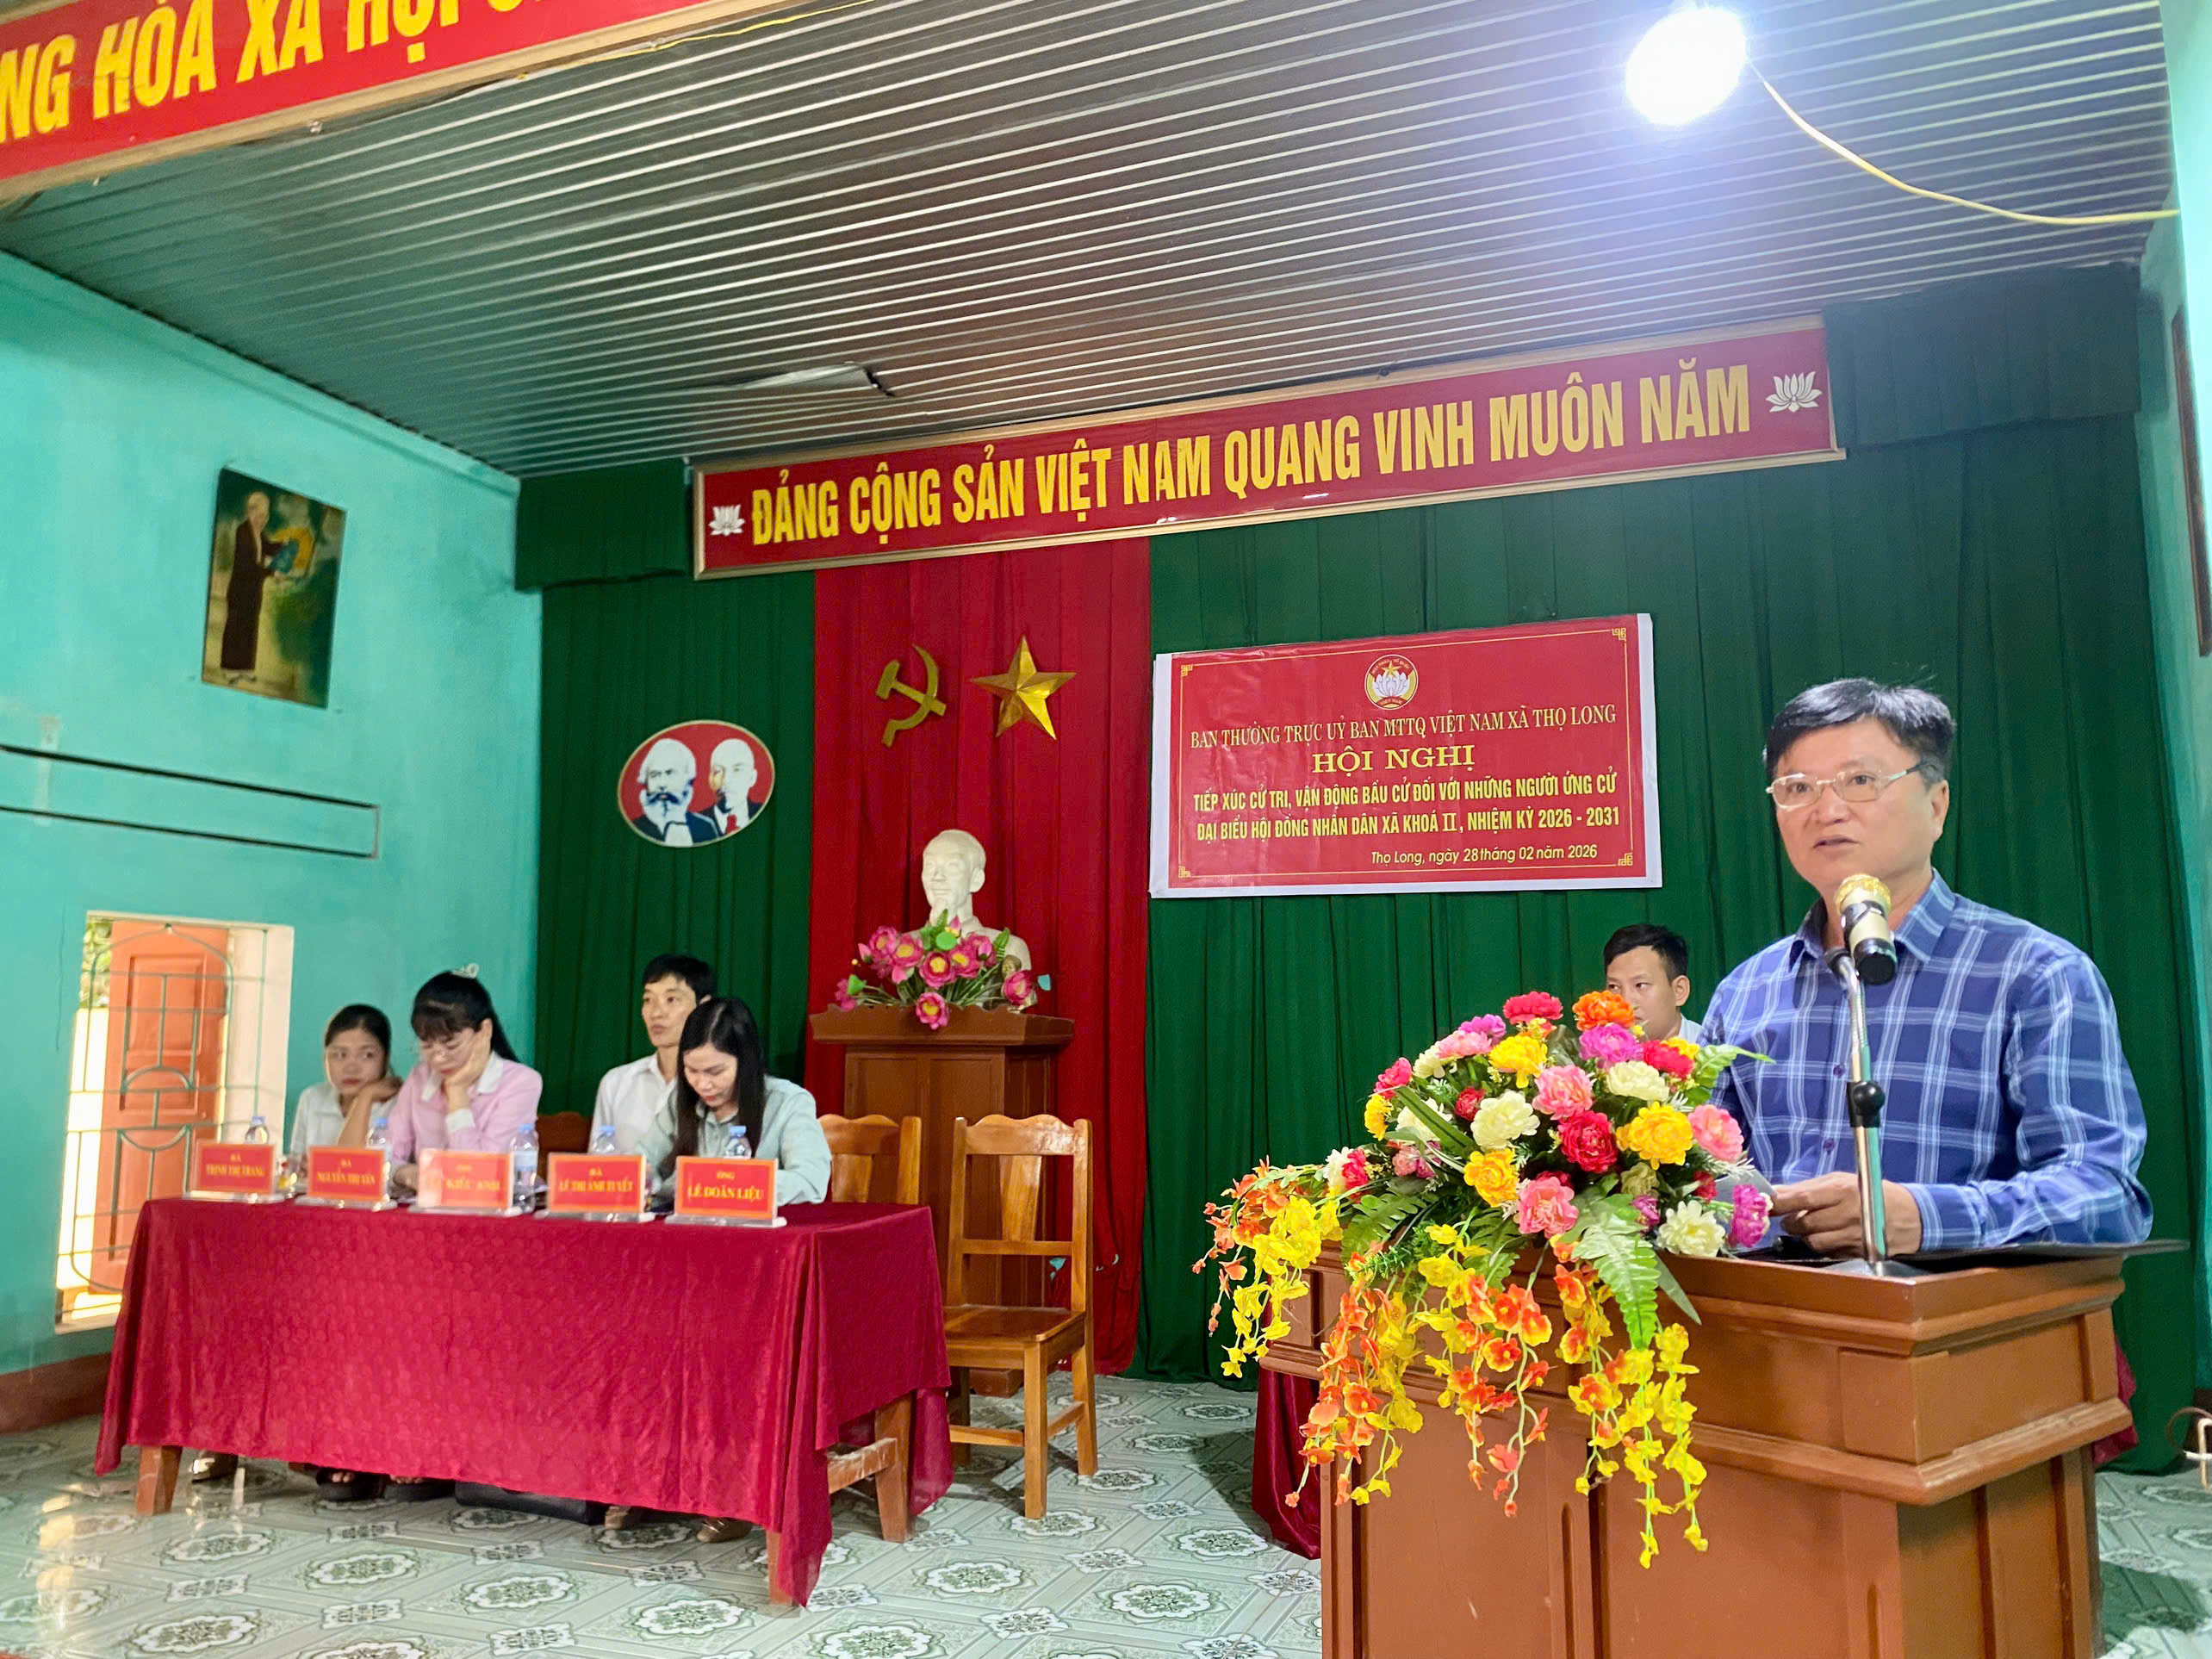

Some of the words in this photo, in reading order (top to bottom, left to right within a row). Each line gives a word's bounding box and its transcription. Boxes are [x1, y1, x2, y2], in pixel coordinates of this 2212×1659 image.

[751, 469, 839, 545] ĐẢNG
[849, 462, 941, 544] CỘNG
[953, 444, 1025, 523] SẢN
[1036, 439, 1111, 522] VIỆT
[1122, 435, 1210, 505] NAM
[1224, 415, 1360, 500] QUANG
[1373, 401, 1474, 475] VINH
[1489, 371, 1624, 462] MUÔN
[1640, 357, 1749, 444] NĂM
[1191, 730, 1218, 749] BAN
[1221, 720, 1281, 746] THƯỜNG
[1283, 722, 1323, 747] TRỰC
[1350, 719, 1379, 739] BAN
[1384, 717, 1426, 738] MTTQ
[1430, 709, 1465, 737] VIỆT
[1469, 711, 1505, 731] NAM
[1507, 705, 1529, 730] XÃ
[1532, 707, 1566, 731] THỌ
[1570, 704, 1617, 725] LONG
[1312, 745, 1374, 777] HỘI
[1385, 744, 1475, 771] NGHỊ
[1194, 787, 1218, 811] TIẾP
[1222, 789, 1246, 811] XÚC
[1250, 783, 1267, 809] CỬ
[1270, 790, 1291, 810] TRI,
[1296, 786, 1320, 811] VẬN
[1323, 784, 1358, 811] ĐỘNG
[1392, 776, 1411, 803] CỬ
[1413, 776, 1435, 802] ĐỐI
[1438, 776, 1460, 800] VỚI
[1464, 775, 1512, 799] NHỮNG
[1515, 772, 1559, 798] NGƯỜI
[1563, 770, 1593, 795] ỨNG
[1596, 766, 1618, 793] CỬ
[1197, 823, 1217, 844] ĐẠI
[1221, 814, 1247, 840] BIỂU
[1252, 817, 1271, 842] HỘI
[1275, 813, 1309, 838] ĐỒNG
[1313, 814, 1347, 836] NHÂN
[1351, 813, 1378, 835] DÂN
[1382, 811, 1400, 834] XÃ
[1402, 810, 1438, 833] KHOÁ
[1468, 807, 1512, 834] NHIỆM
[1516, 805, 1534, 829] KỲ
[1538, 808, 1572, 828] 2026
[1586, 806, 1619, 827] 2031
[1371, 851, 1391, 866] Thọ
[1394, 850, 1425, 866] Long,
[1429, 848, 1459, 865] ngày
[1463, 848, 1479, 862] 28
[1480, 847, 1515, 863] tháng
[1519, 847, 1533, 860] 02
[1537, 846, 1564, 859] năm
[1568, 844, 1597, 858] 2026
